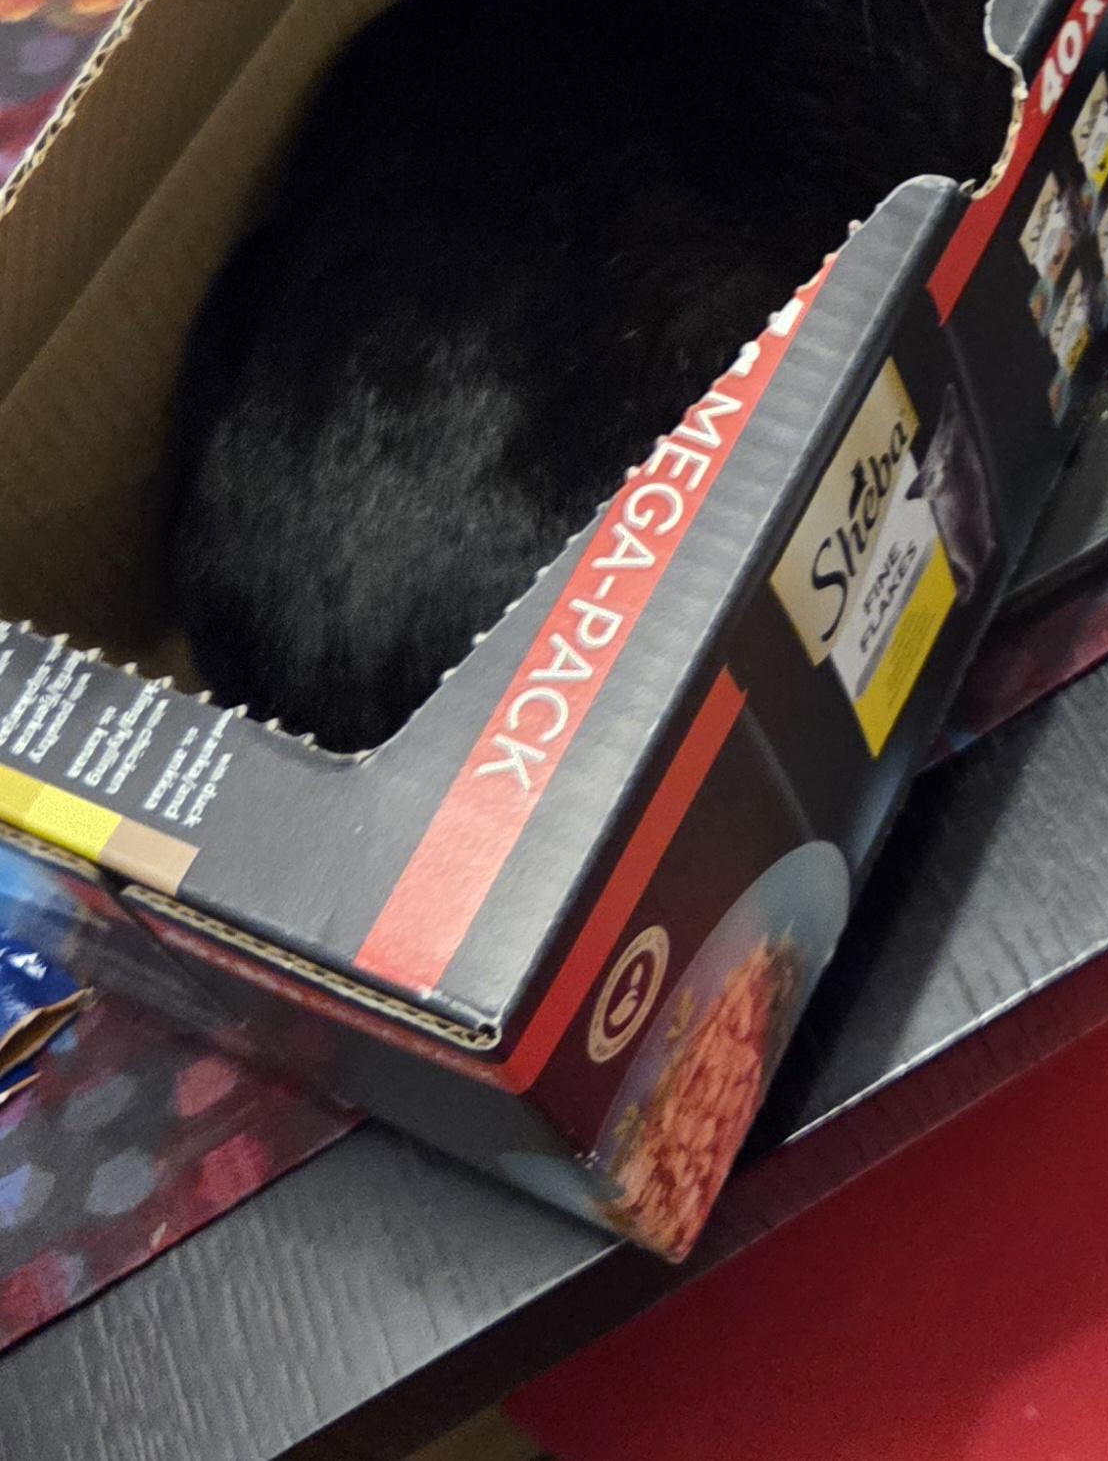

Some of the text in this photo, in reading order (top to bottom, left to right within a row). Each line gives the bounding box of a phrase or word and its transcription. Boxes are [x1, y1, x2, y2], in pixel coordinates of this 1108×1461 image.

[472, 389, 744, 791] MEGA-PACK
[812, 421, 909, 642] Sheba
[859, 541, 917, 654] FLAKES
[863, 540, 902, 616] FINE
